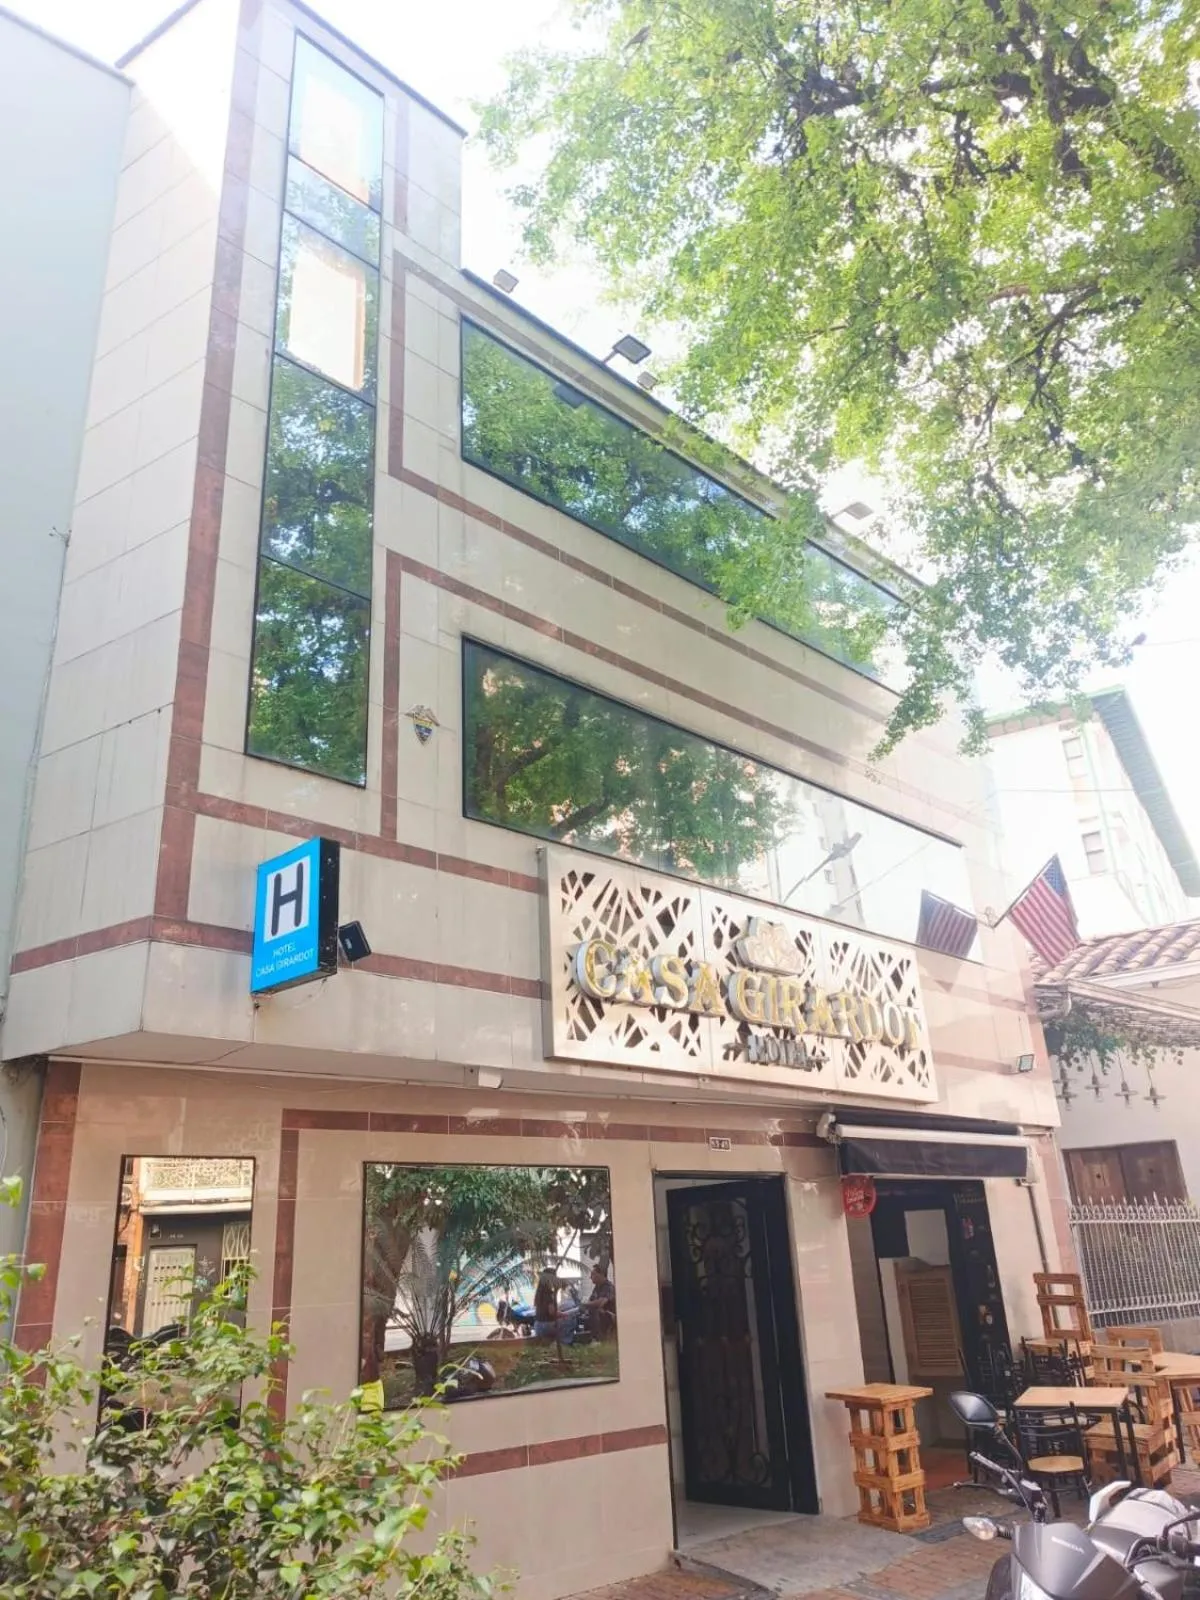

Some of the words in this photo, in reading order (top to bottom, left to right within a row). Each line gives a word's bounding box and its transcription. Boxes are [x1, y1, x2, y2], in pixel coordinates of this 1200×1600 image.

[271, 862, 304, 937] H
[255, 963, 275, 978] CASA
[276, 947, 315, 969] GIRARDOT
[272, 941, 296, 958] HOTEL
[575, 937, 726, 1018] CASA
[727, 967, 922, 1051] GIRARDOT
[747, 1033, 813, 1072] HOTEL
